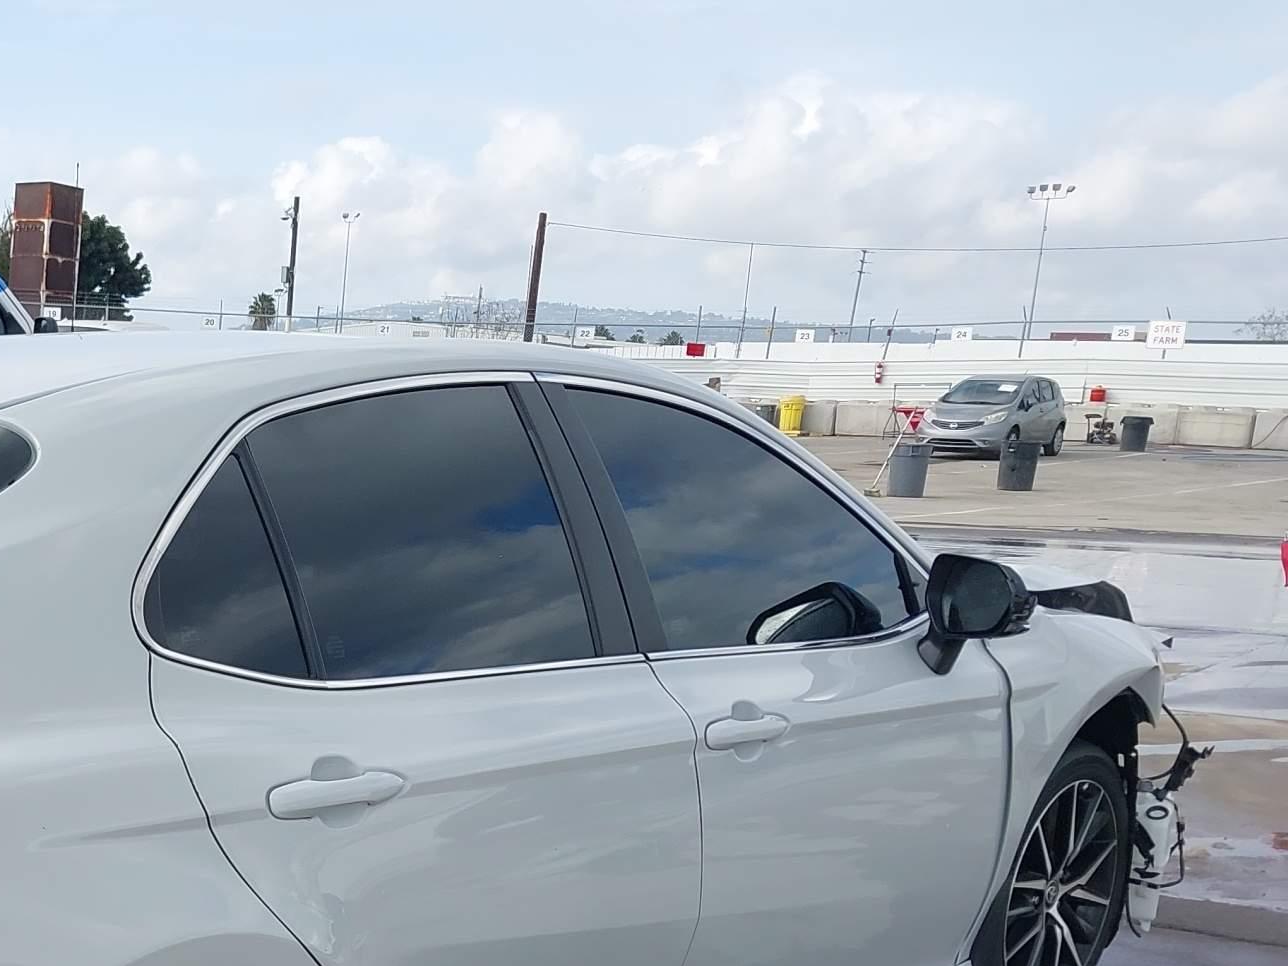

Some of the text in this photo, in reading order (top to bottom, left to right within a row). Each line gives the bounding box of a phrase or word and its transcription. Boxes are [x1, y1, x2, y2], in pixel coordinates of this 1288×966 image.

[204, 318, 215, 327] 20
[380, 325, 390, 334] 21
[1117, 329, 1130, 338] 25
[1153, 324, 1183, 334] STATE
[580, 330, 591, 338] 22
[799, 332, 810, 340] 23
[956, 331, 968, 339] 24
[1152, 336, 1179, 345] FARM
